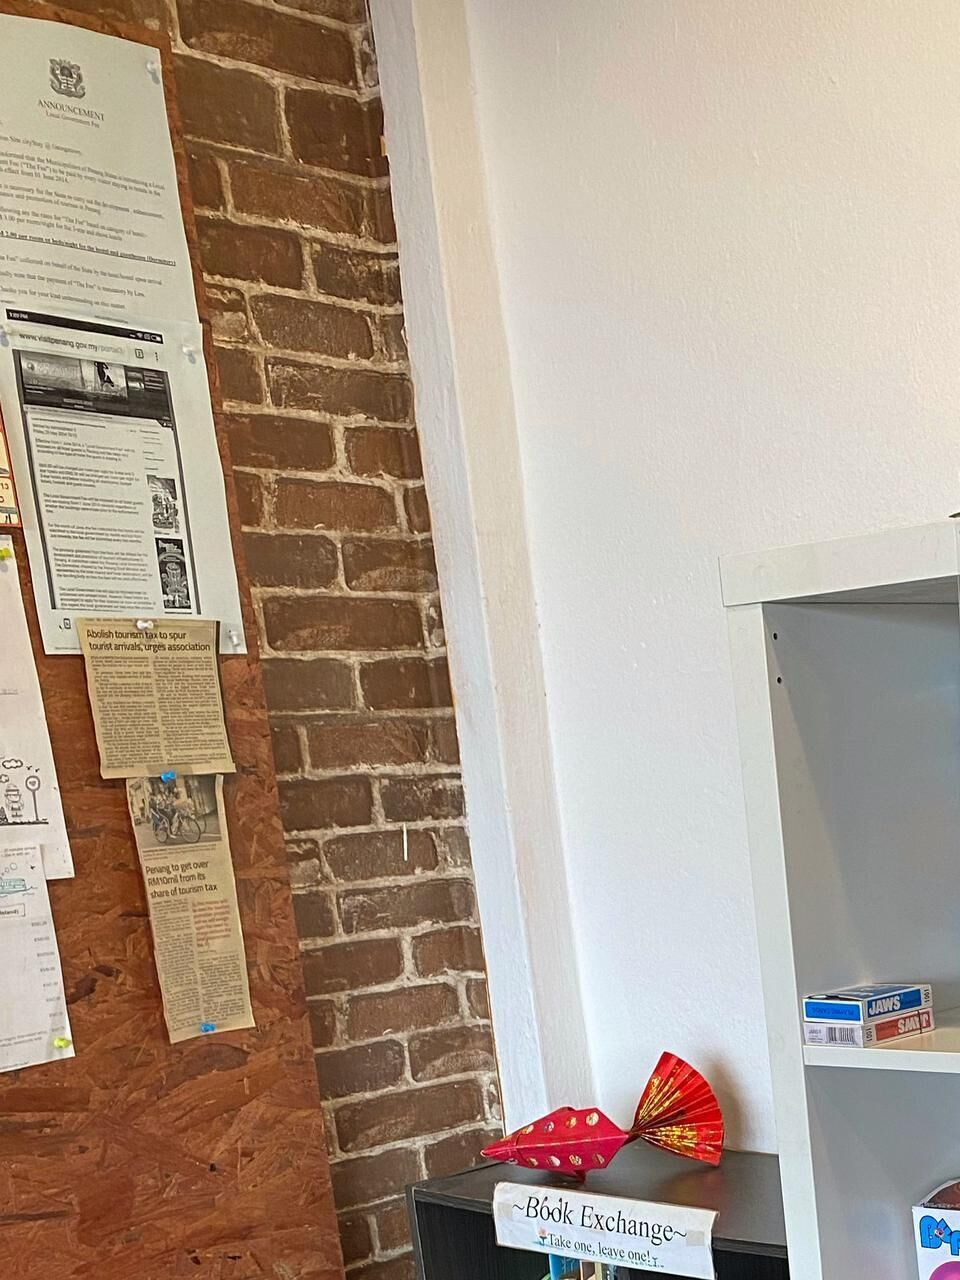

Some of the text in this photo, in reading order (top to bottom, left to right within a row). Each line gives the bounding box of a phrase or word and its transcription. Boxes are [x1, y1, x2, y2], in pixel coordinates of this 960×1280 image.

[37, 99, 105, 122] ANNOUNCEMENT
[86, 629, 187, 641] Abolish tourism tax to spur
[88, 642, 211, 653] tourist arrivals, urges association
[145, 861, 209, 875] Penang to get over
[147, 873, 206, 887] RM10mil from its
[150, 883, 218, 899] share of tourism tax
[868, 994, 900, 1016] JAWS
[897, 1014, 929, 1034] JAWS
[547, 1233, 651, 1262] Take one, leave one!
